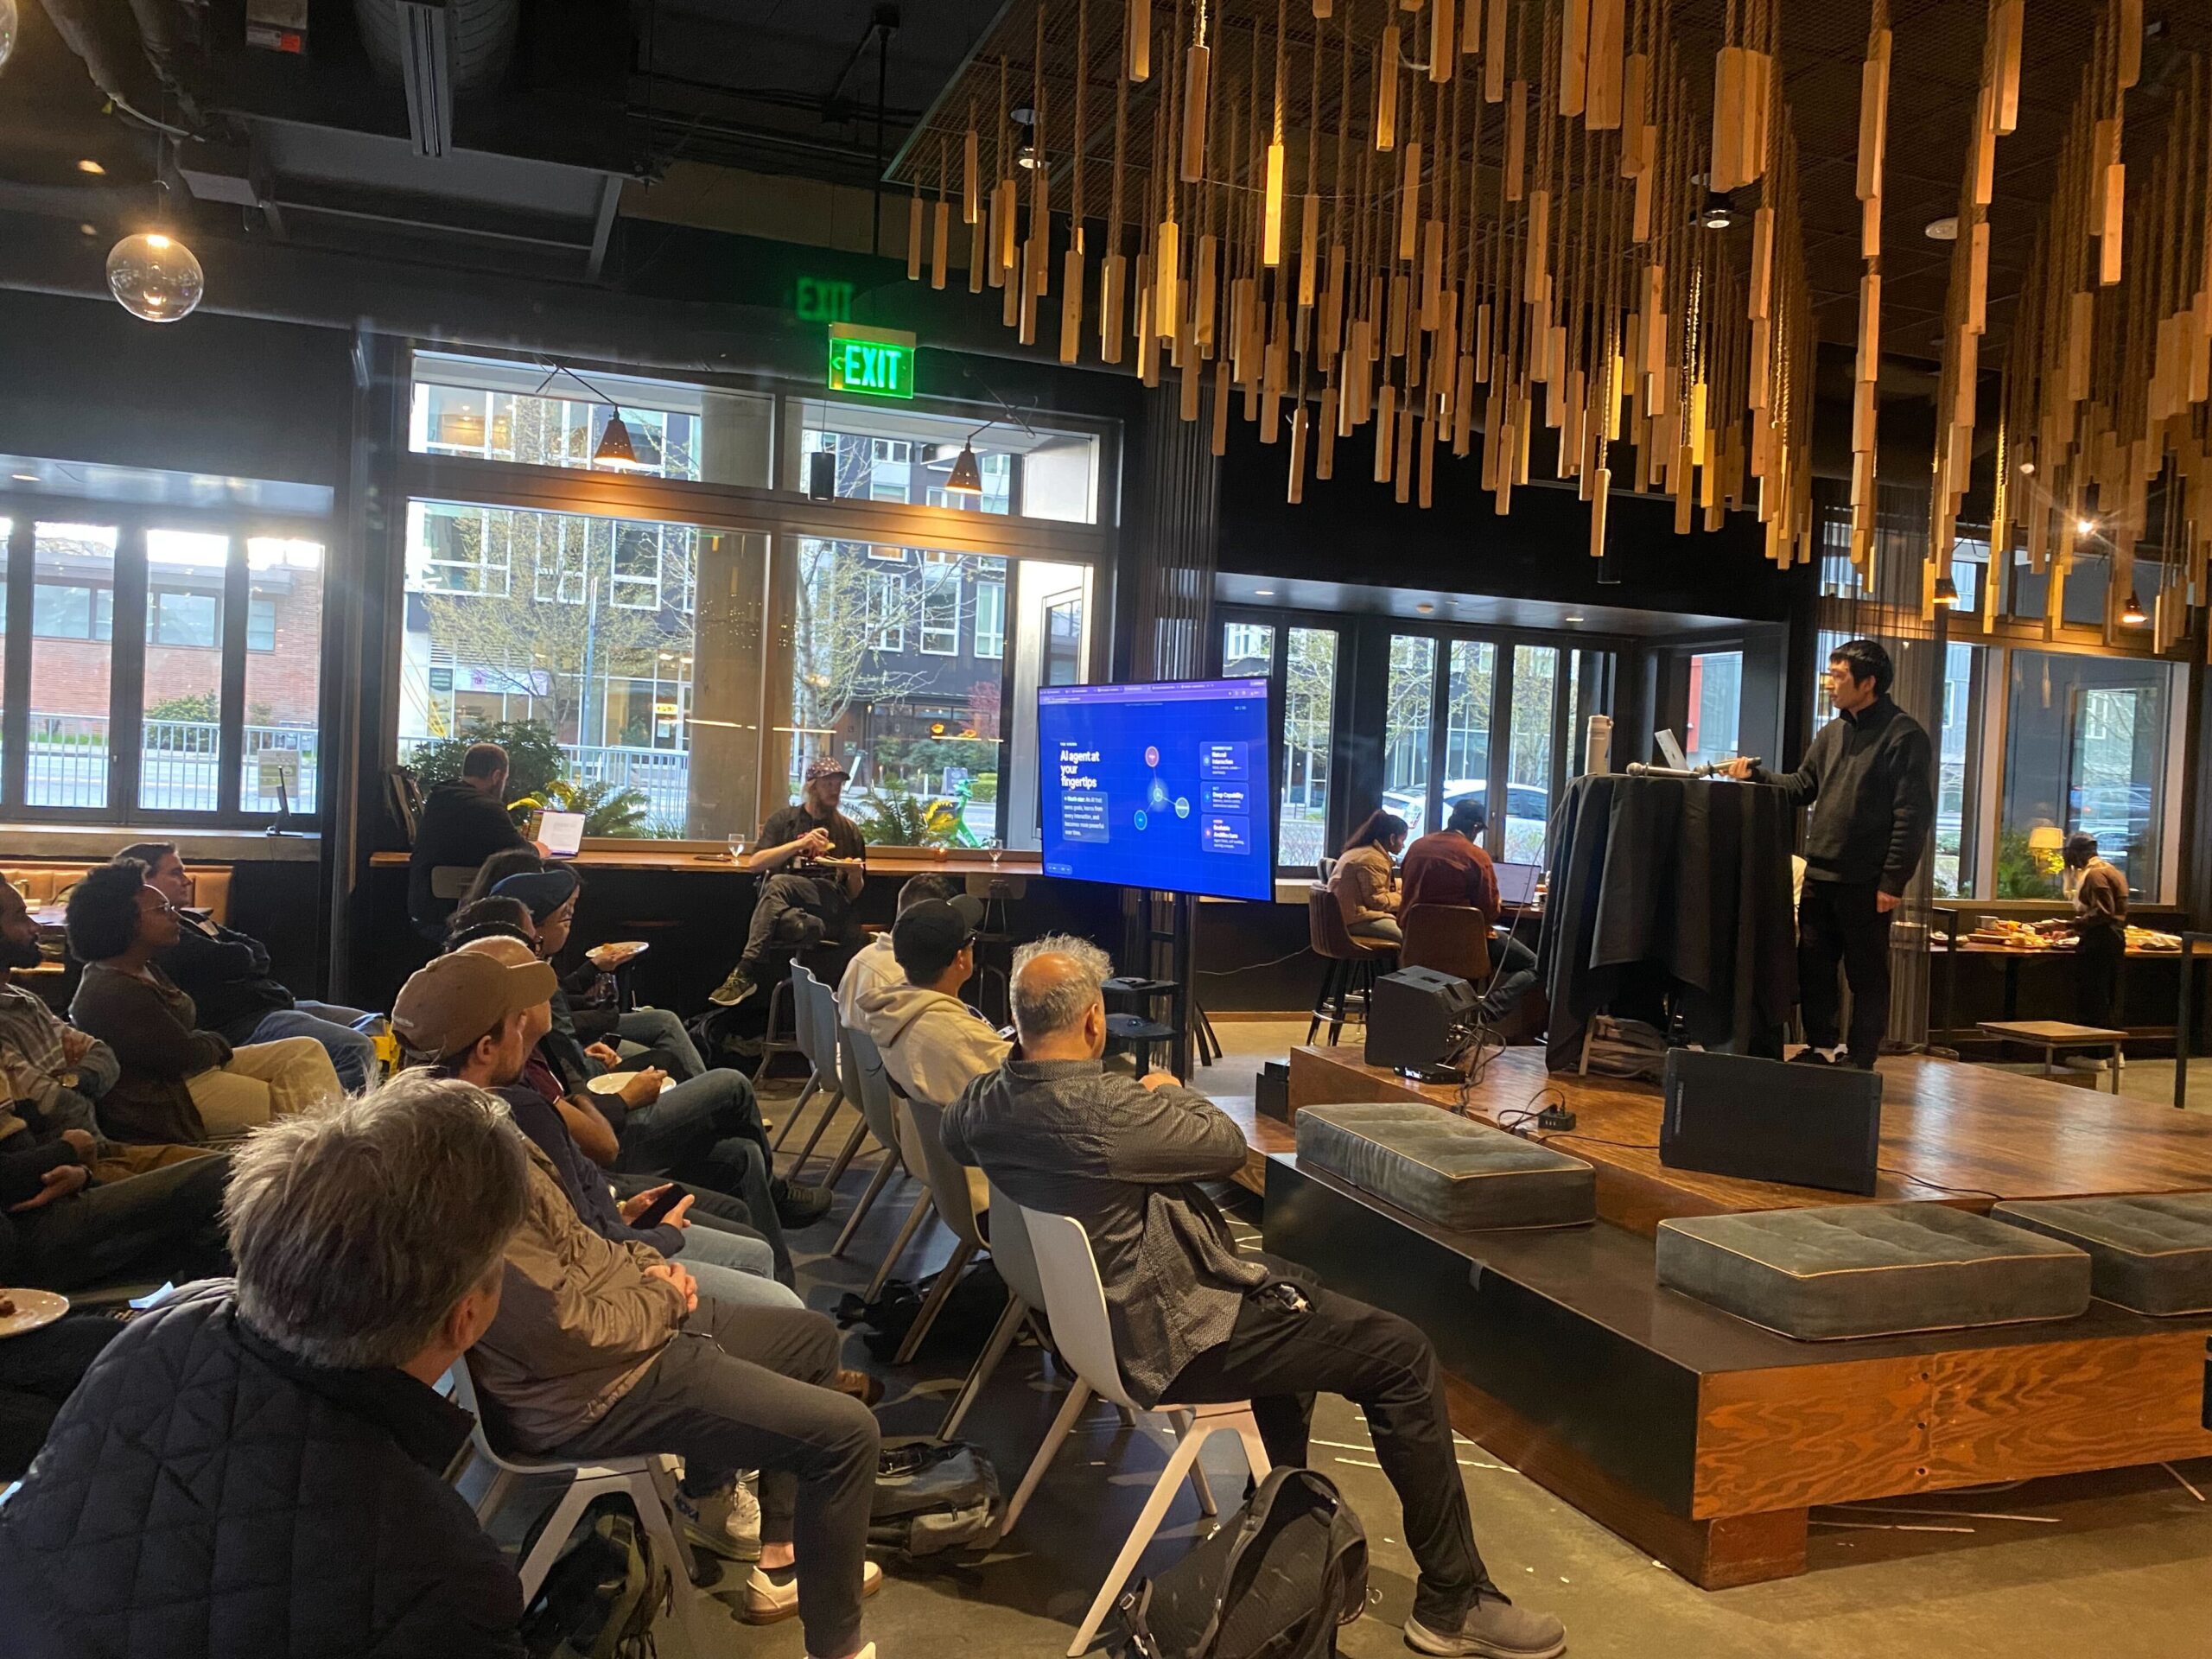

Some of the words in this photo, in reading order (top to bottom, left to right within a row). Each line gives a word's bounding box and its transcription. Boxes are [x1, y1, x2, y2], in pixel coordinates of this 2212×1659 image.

[797, 276, 855, 321] EXIT
[844, 344, 902, 390] EXIT
[1059, 749, 1069, 761] AI
[1069, 751, 1090, 765] agent
[1090, 751, 1100, 762] at
[1060, 765, 1078, 777] your
[1061, 776, 1097, 790] fingertips
